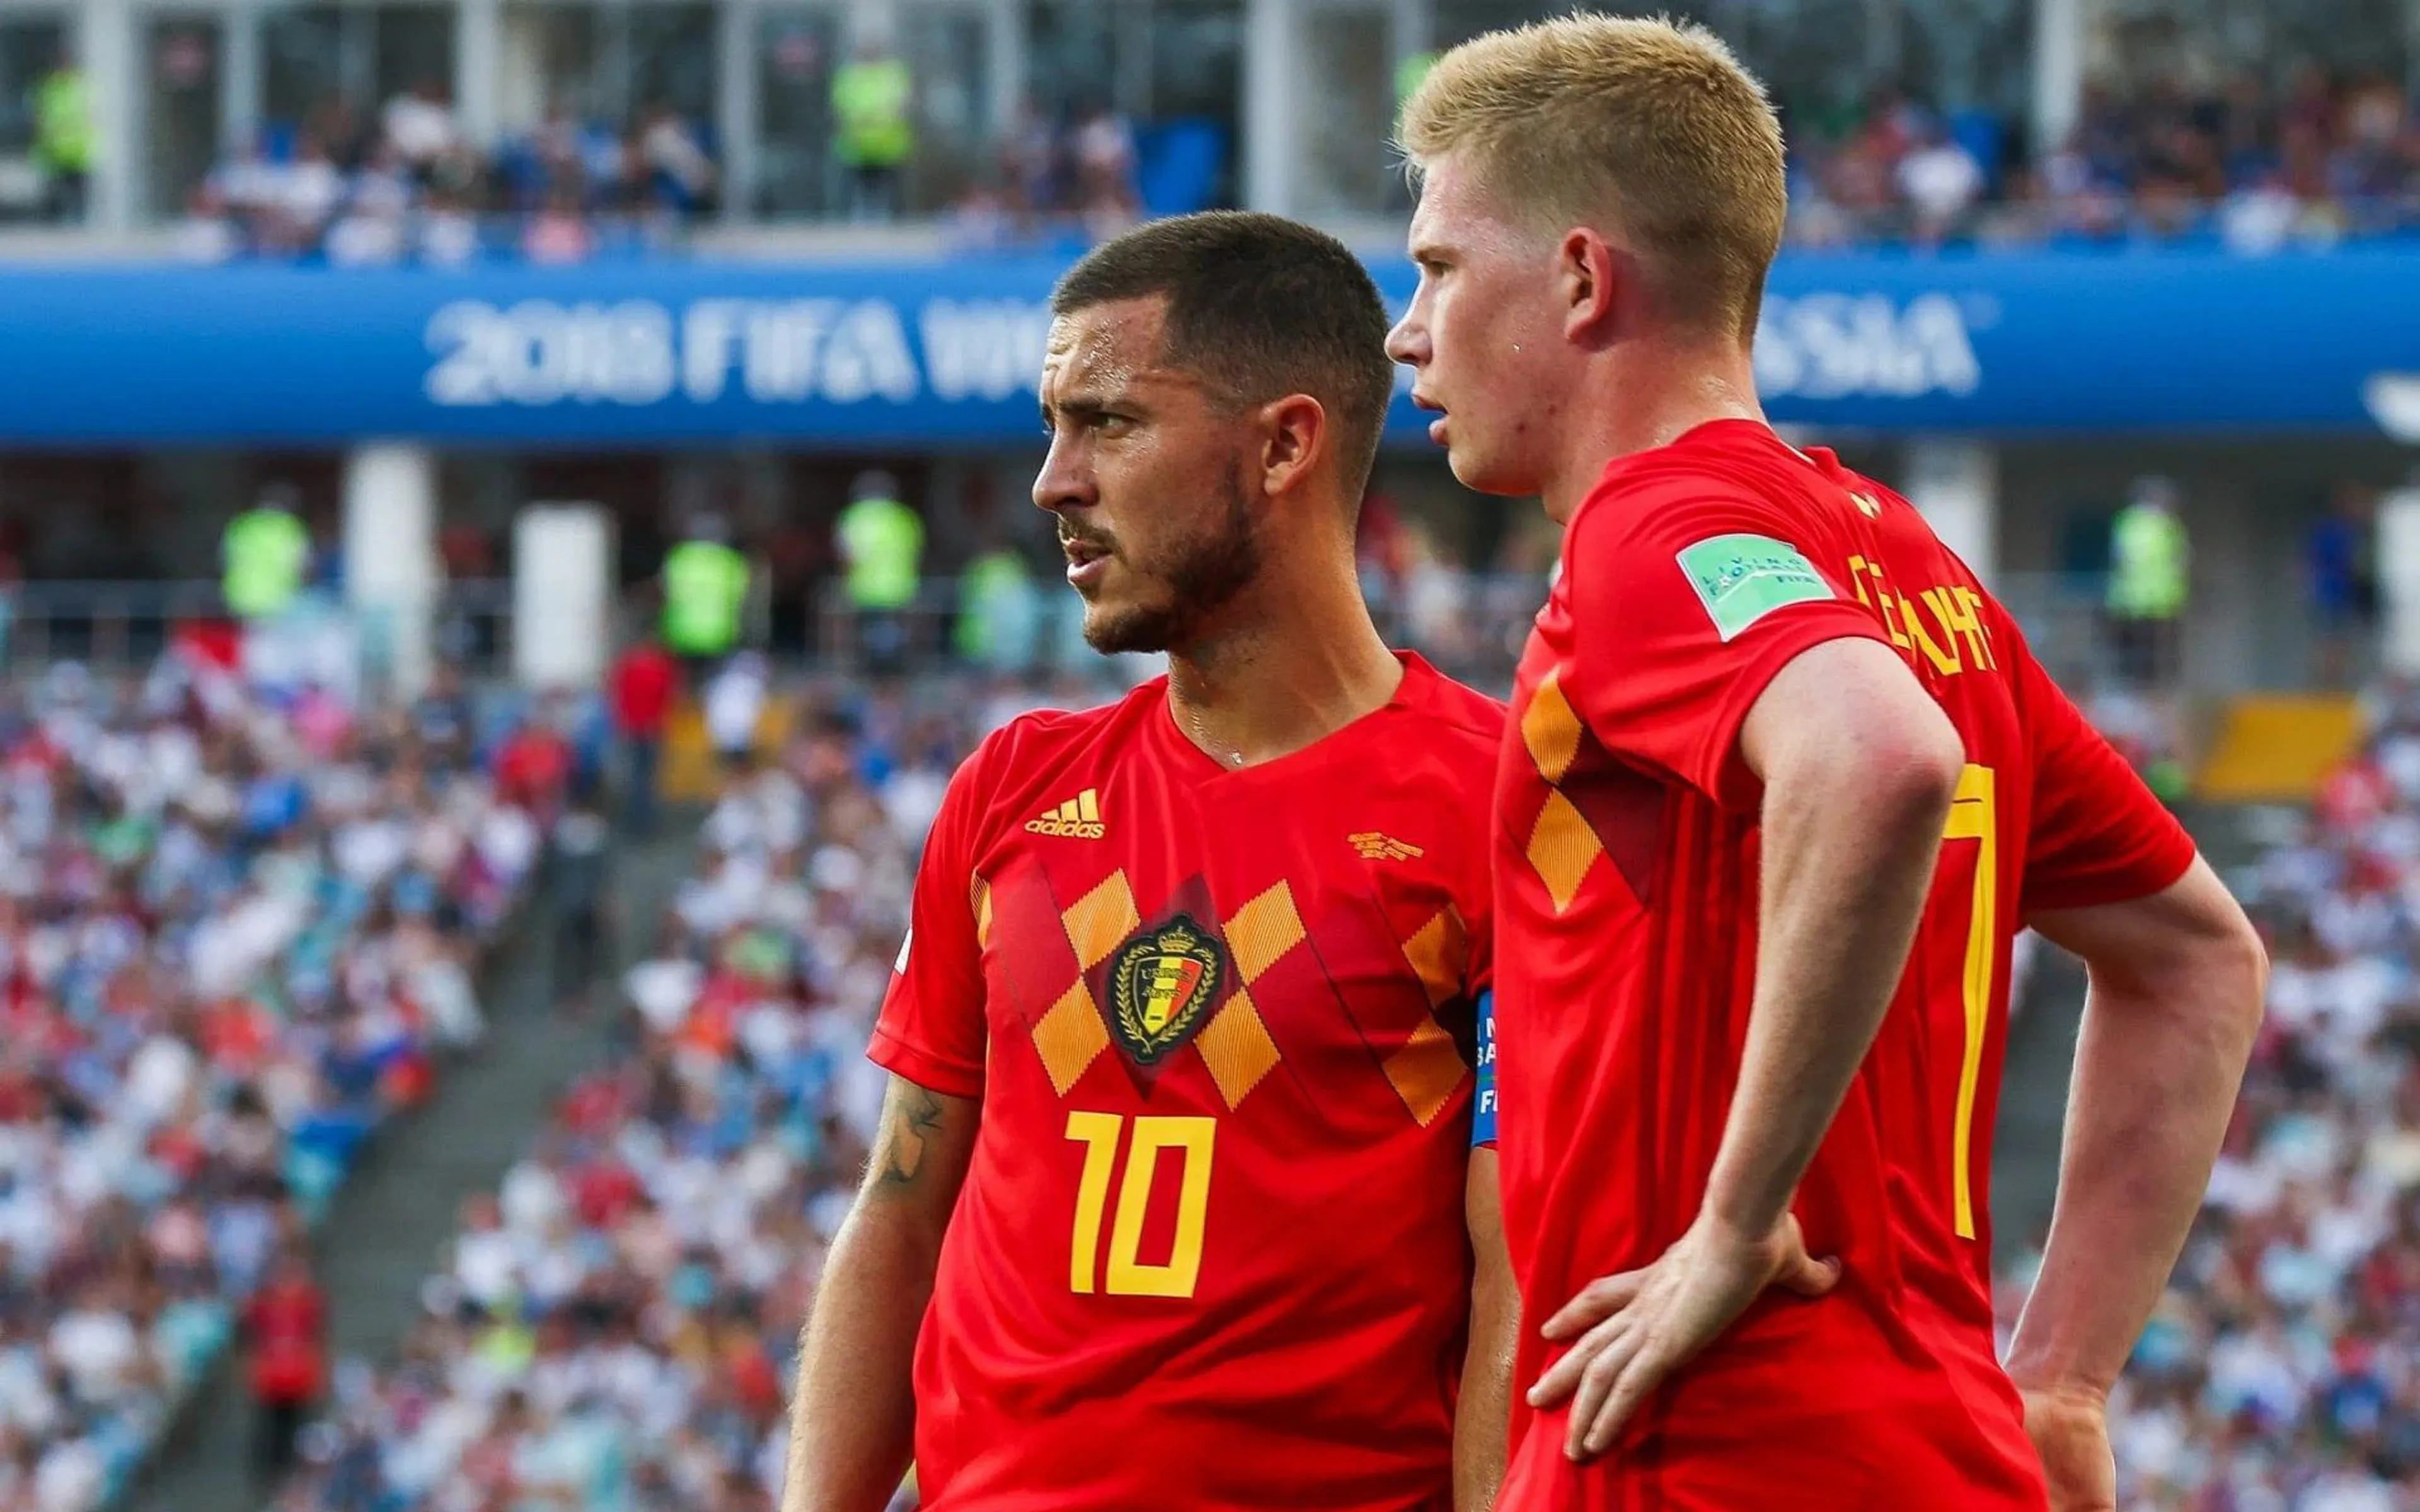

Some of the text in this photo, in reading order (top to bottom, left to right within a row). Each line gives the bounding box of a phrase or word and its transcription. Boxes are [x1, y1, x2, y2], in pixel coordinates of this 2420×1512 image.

[426, 299, 672, 404] 2018
[684, 297, 919, 403] FIFA
[1025, 819, 1105, 839] adidas
[1064, 1110, 1217, 1298] 10
